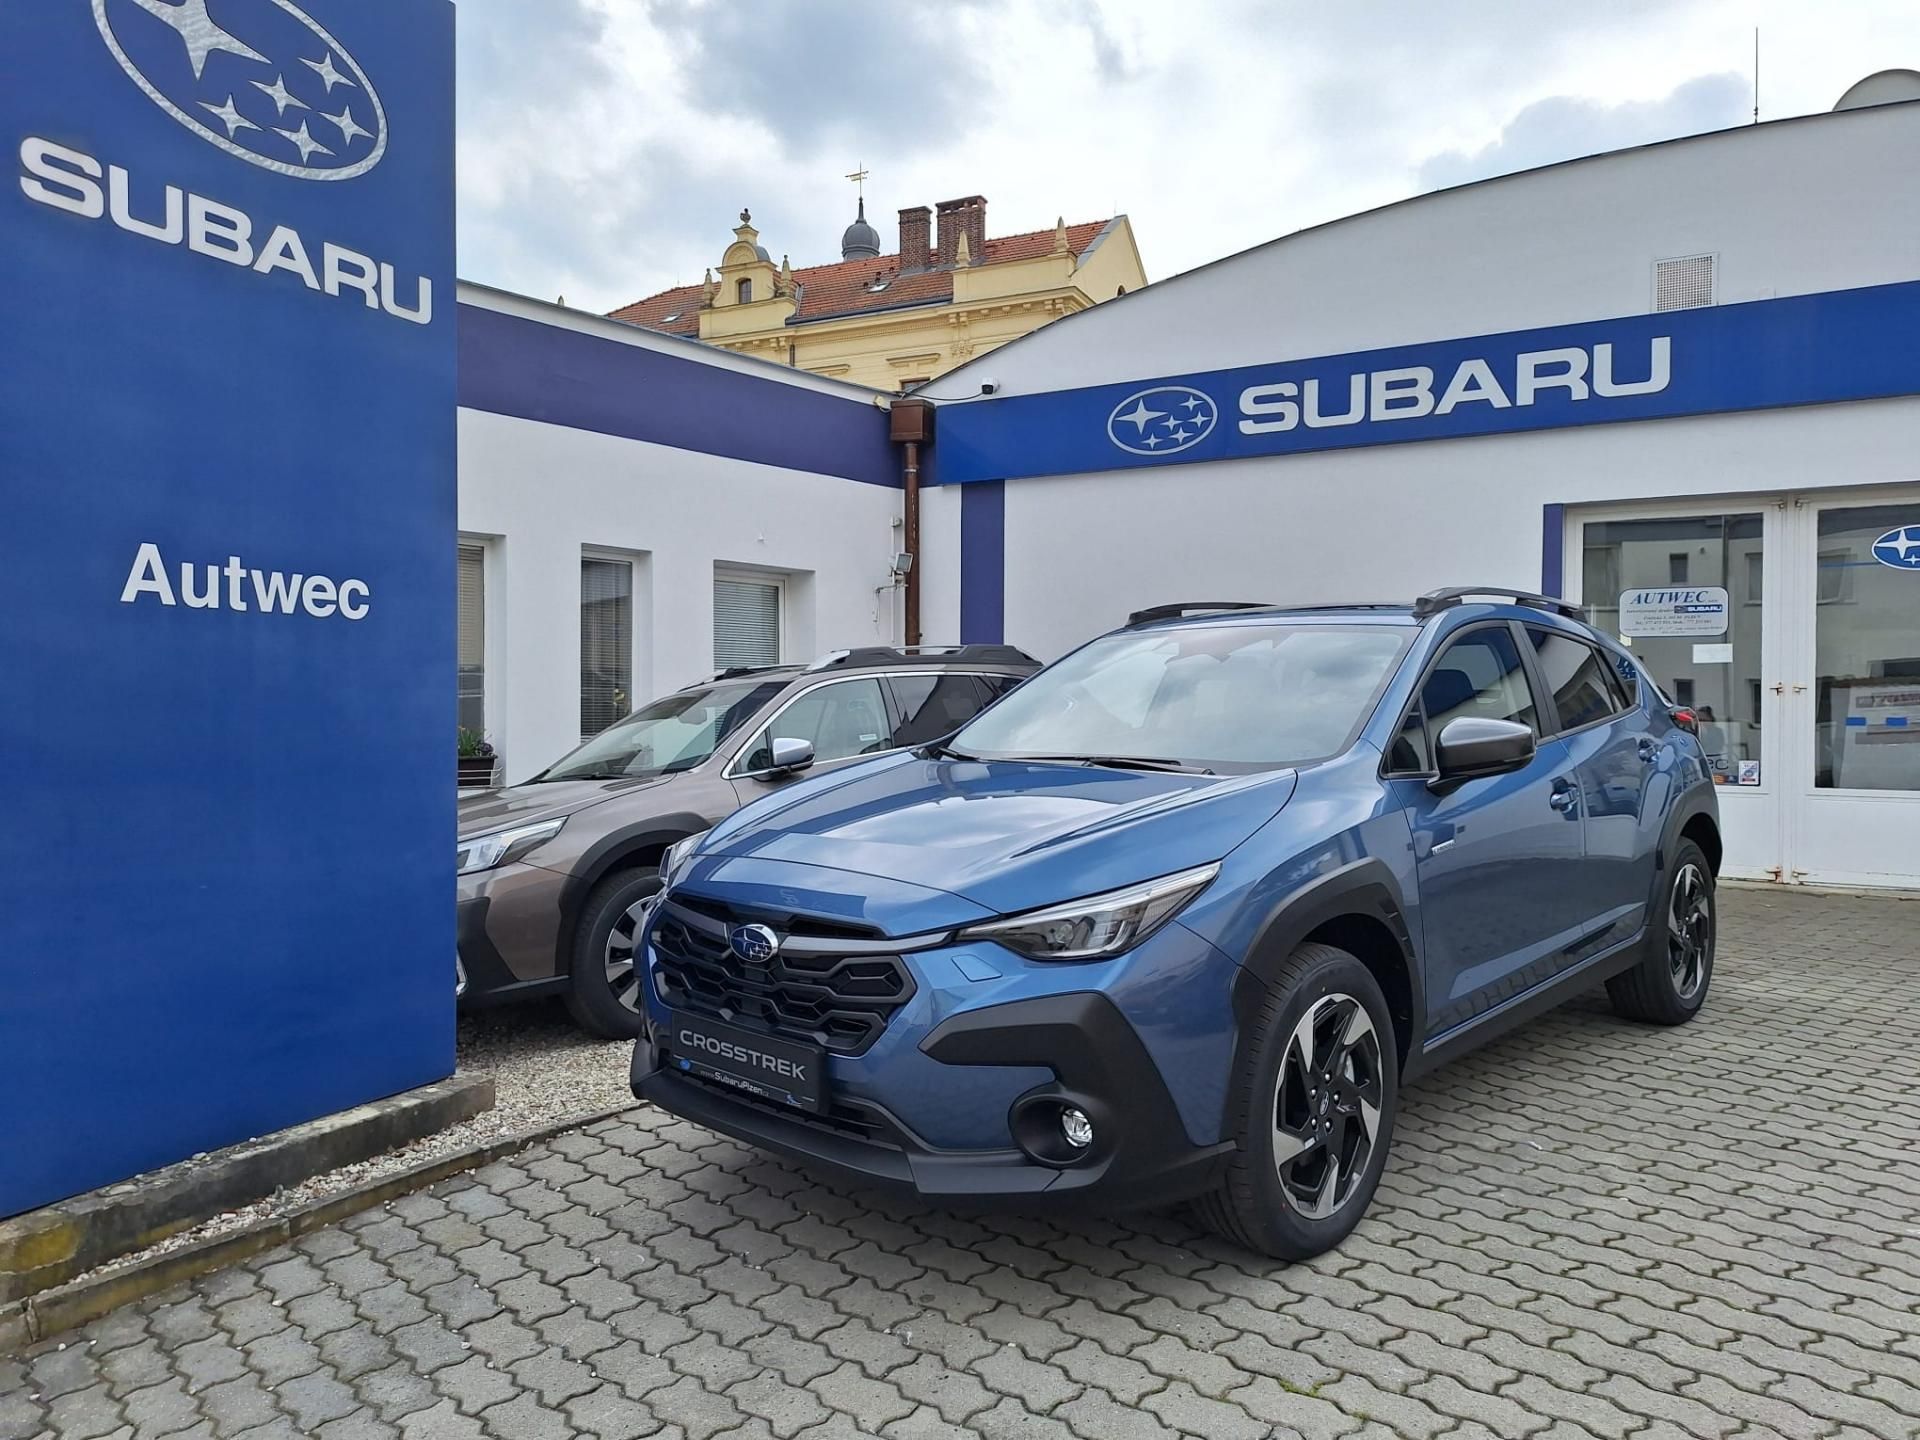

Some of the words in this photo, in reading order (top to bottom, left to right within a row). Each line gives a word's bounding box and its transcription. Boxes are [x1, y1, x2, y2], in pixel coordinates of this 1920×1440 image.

[20, 137, 432, 324] SUBARU
[1239, 337, 1671, 435] SUBARU
[121, 543, 370, 619] Autwec
[1631, 591, 1708, 604] AUTWEC
[680, 1030, 805, 1080] CROSSTREK
